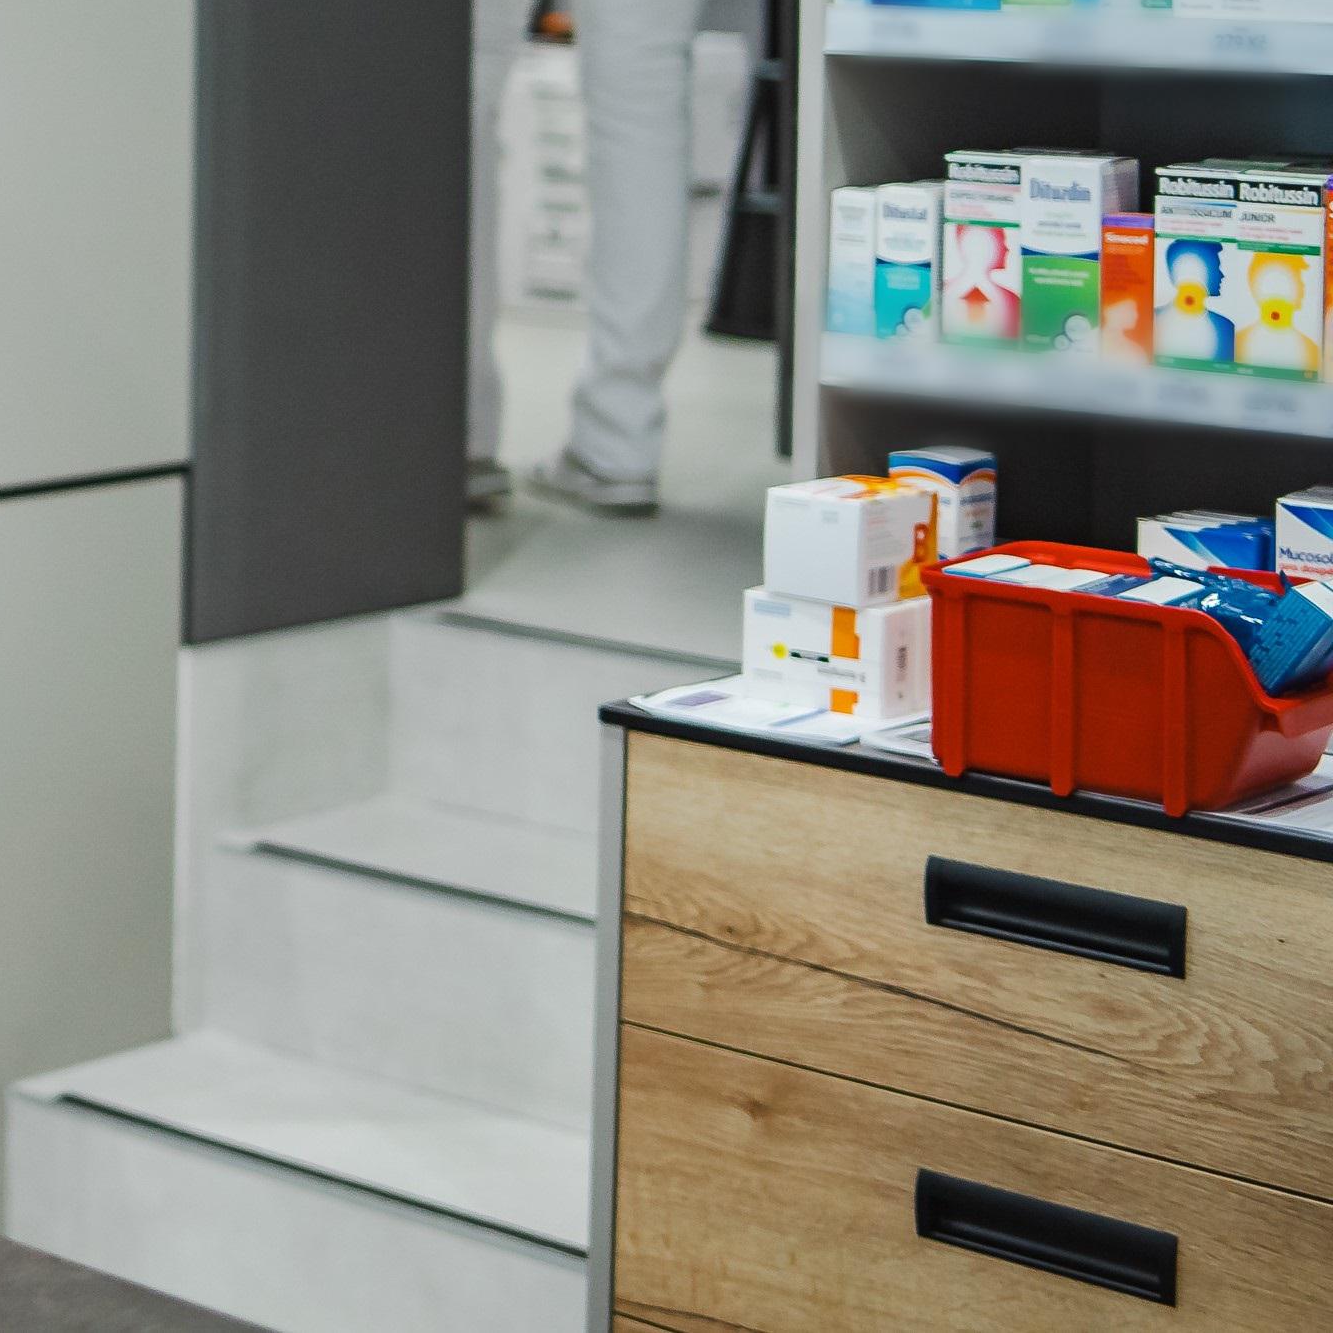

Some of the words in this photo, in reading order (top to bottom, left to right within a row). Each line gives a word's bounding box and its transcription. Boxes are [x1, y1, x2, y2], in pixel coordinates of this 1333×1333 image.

[1159, 177, 1235, 199] Robitussin
[1239, 182, 1319, 205] Robitussin
[1239, 211, 1276, 224] JUNIOR
